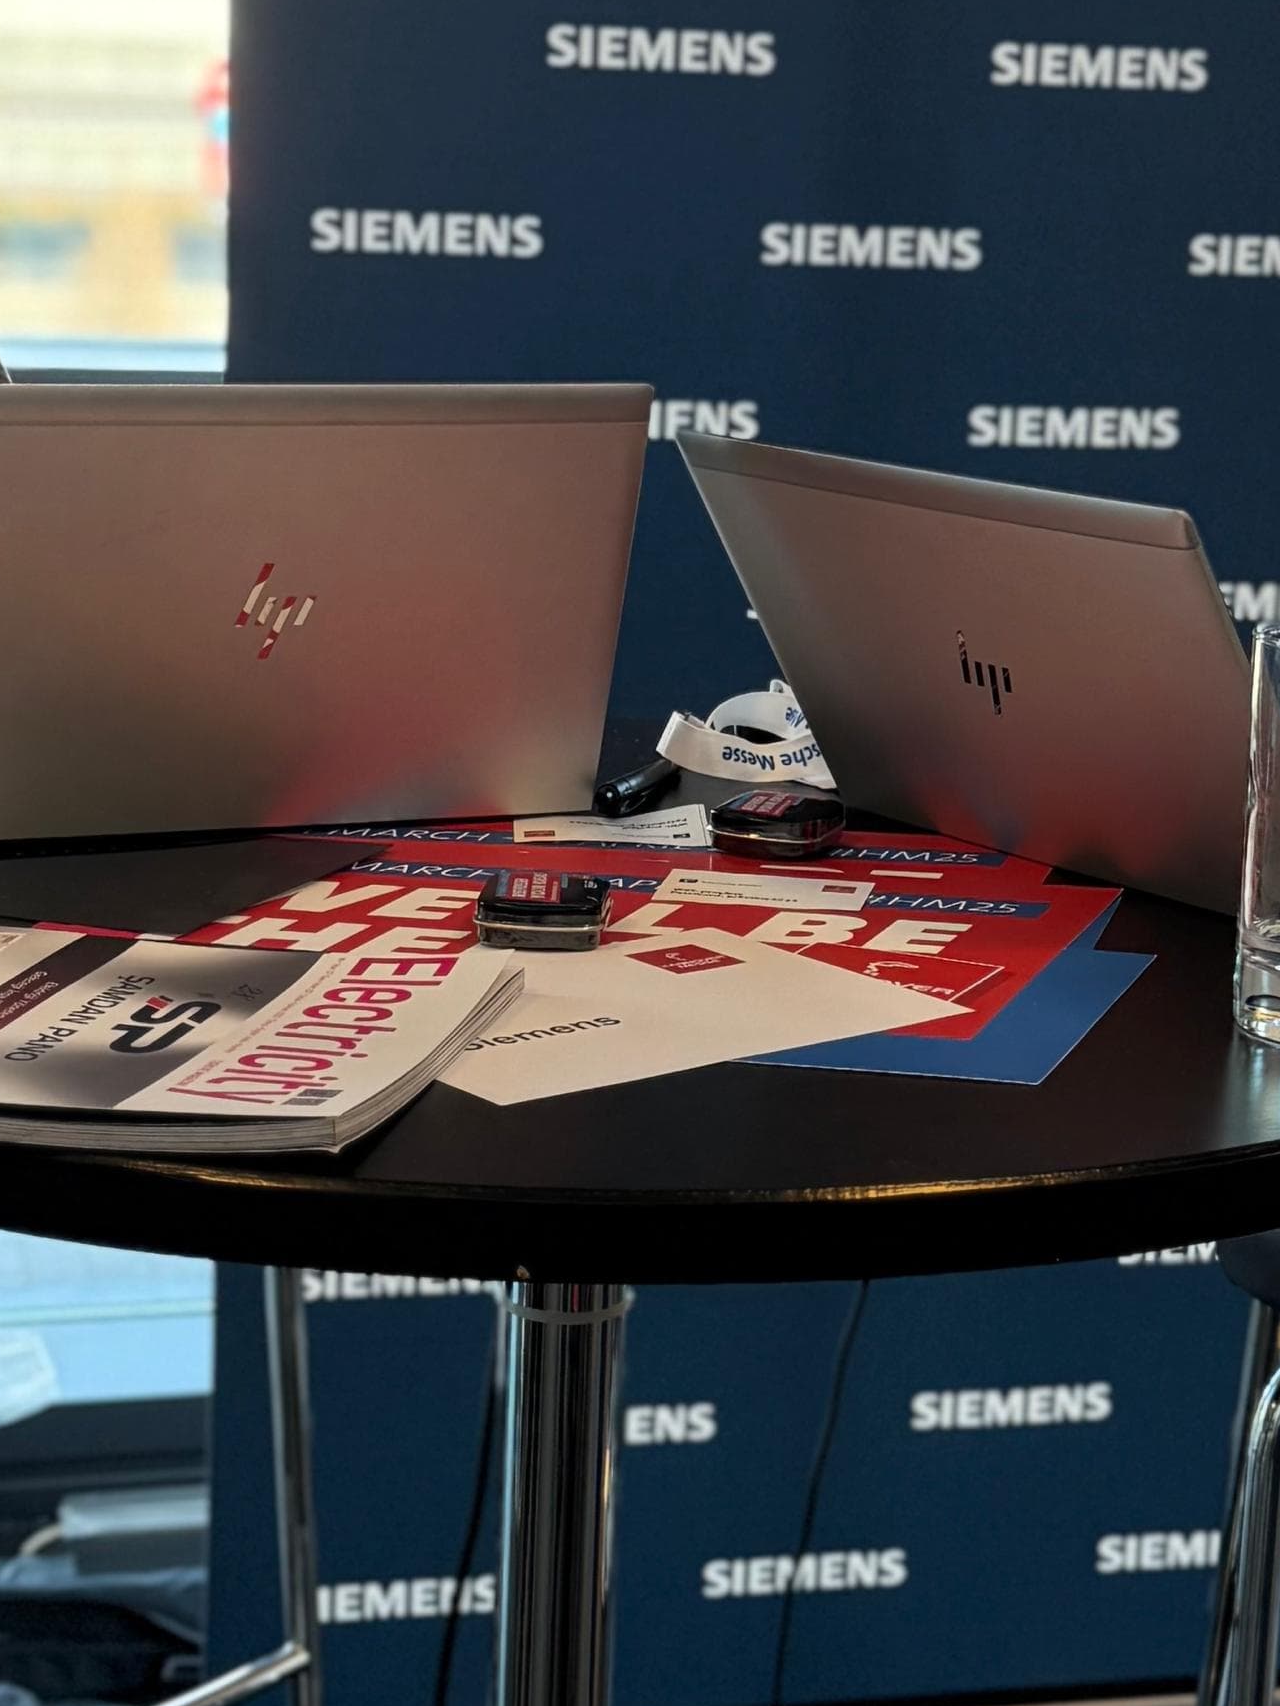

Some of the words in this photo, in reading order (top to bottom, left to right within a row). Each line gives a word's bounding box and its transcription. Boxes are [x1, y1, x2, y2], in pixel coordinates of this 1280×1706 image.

[546, 23, 777, 77] SIEMENS
[990, 42, 1209, 91] SIEMENS
[310, 208, 544, 259] SIEMENS
[760, 222, 983, 271] SIEMENS
[967, 405, 1181, 449] SIEMENS
[721, 746, 776, 771] Messe
[781, 742, 821, 768] sche
[3, 1026, 79, 1063] PANO
[166, 956, 457, 1105] Electricity
[910, 1381, 1113, 1431] SIEMENS
[702, 1548, 908, 1599] SIEMENS
[1096, 1529, 1223, 1574] SIEM
[316, 1574, 497, 1625] IEMENS
